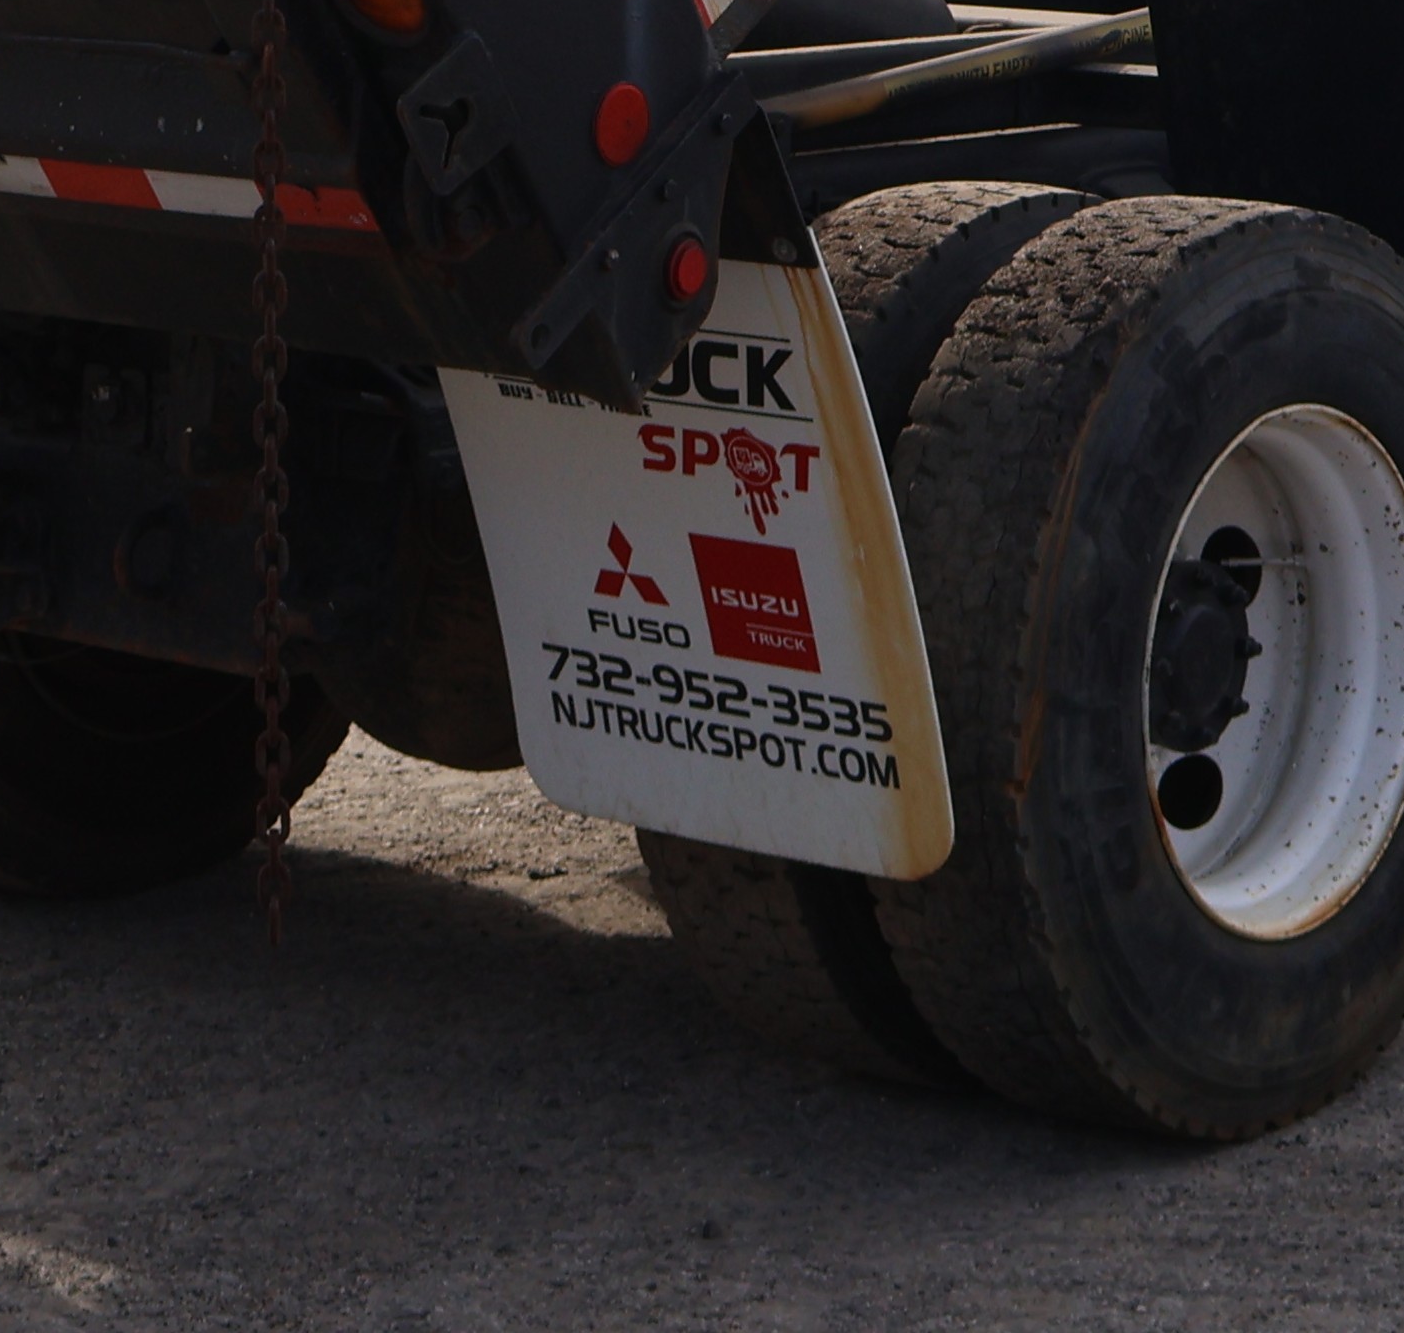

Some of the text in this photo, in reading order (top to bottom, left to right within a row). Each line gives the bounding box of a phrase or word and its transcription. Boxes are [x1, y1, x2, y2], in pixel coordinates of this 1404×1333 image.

[498, 383, 533, 400] BUY
[639, 423, 820, 492] SPOT
[711, 585, 799, 618] ISUZU
[587, 608, 691, 650] FUSO
[749, 629, 807, 653] TRUCK
[542, 643, 893, 742] 732-952-3535
[552, 691, 900, 789] NJTRUCKSPOT.COM
